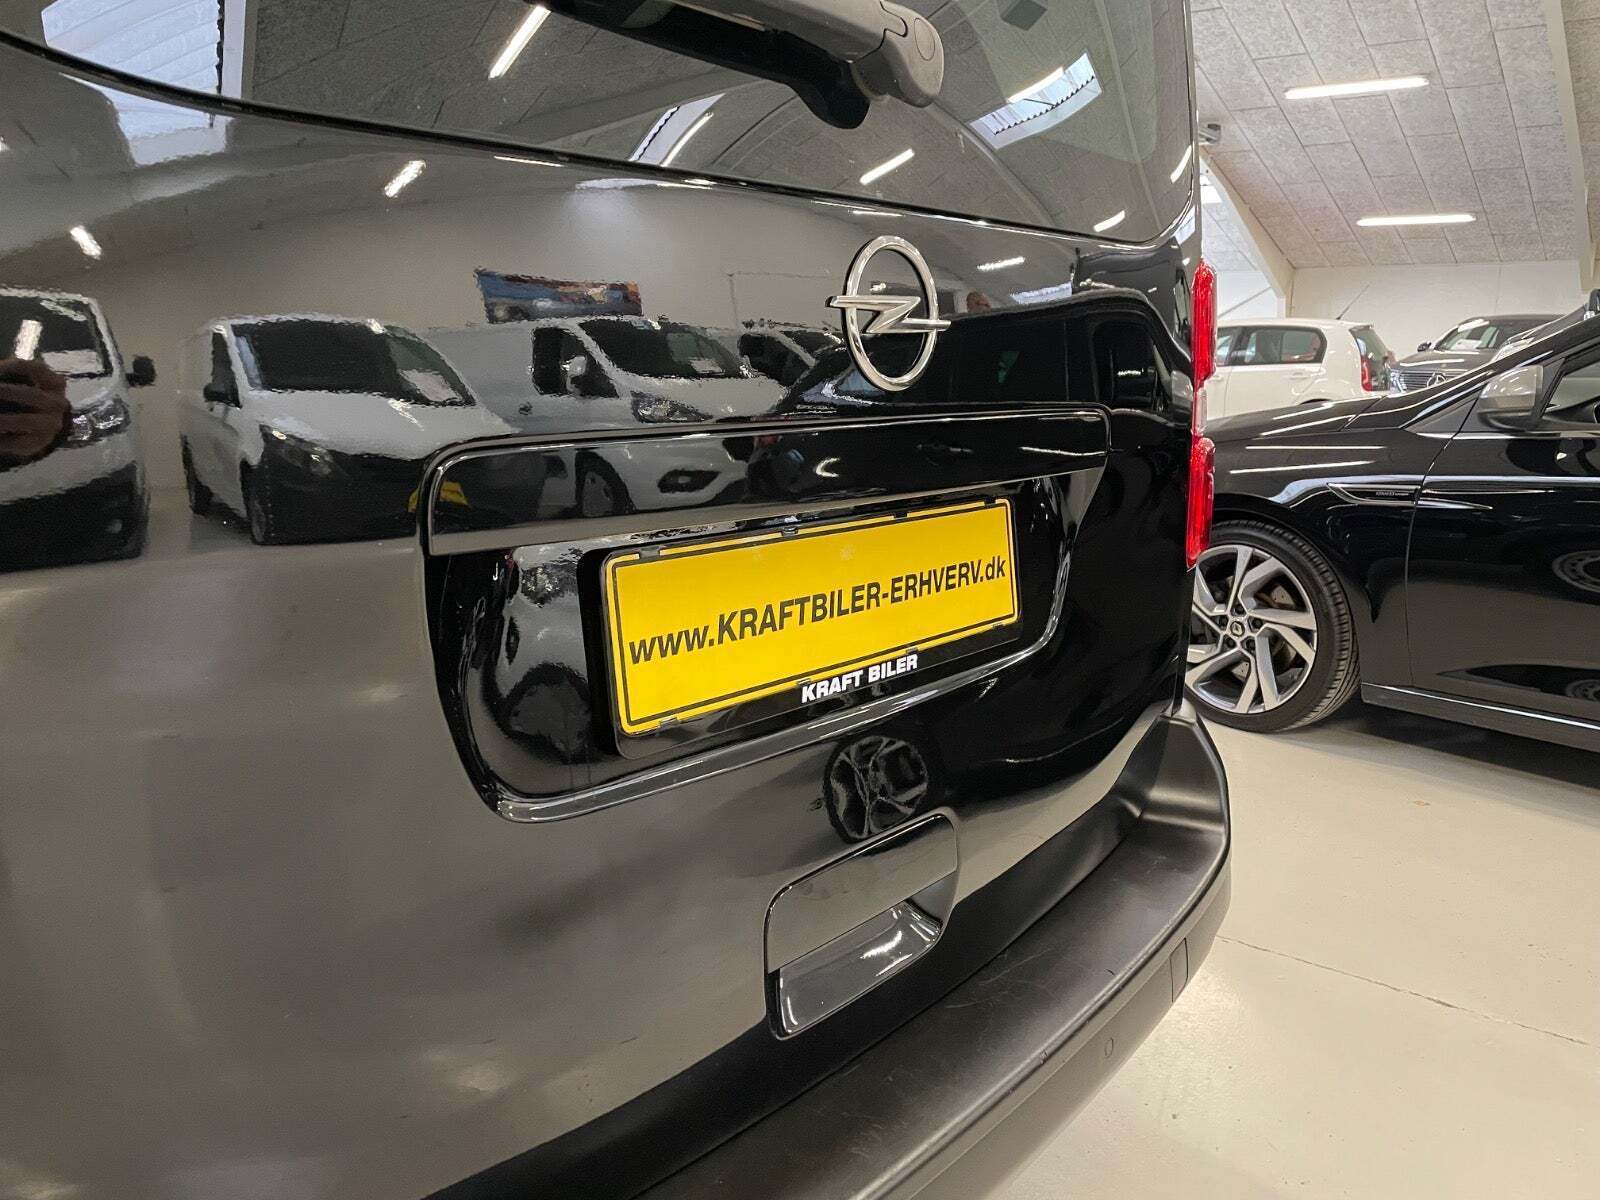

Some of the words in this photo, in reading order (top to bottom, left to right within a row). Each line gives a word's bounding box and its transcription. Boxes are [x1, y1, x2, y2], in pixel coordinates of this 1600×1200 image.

[629, 556, 1006, 665] www.KRAFTBILER-ERHVERV.dk
[801, 669, 864, 704] KRAFT
[867, 653, 918, 683] BILER
